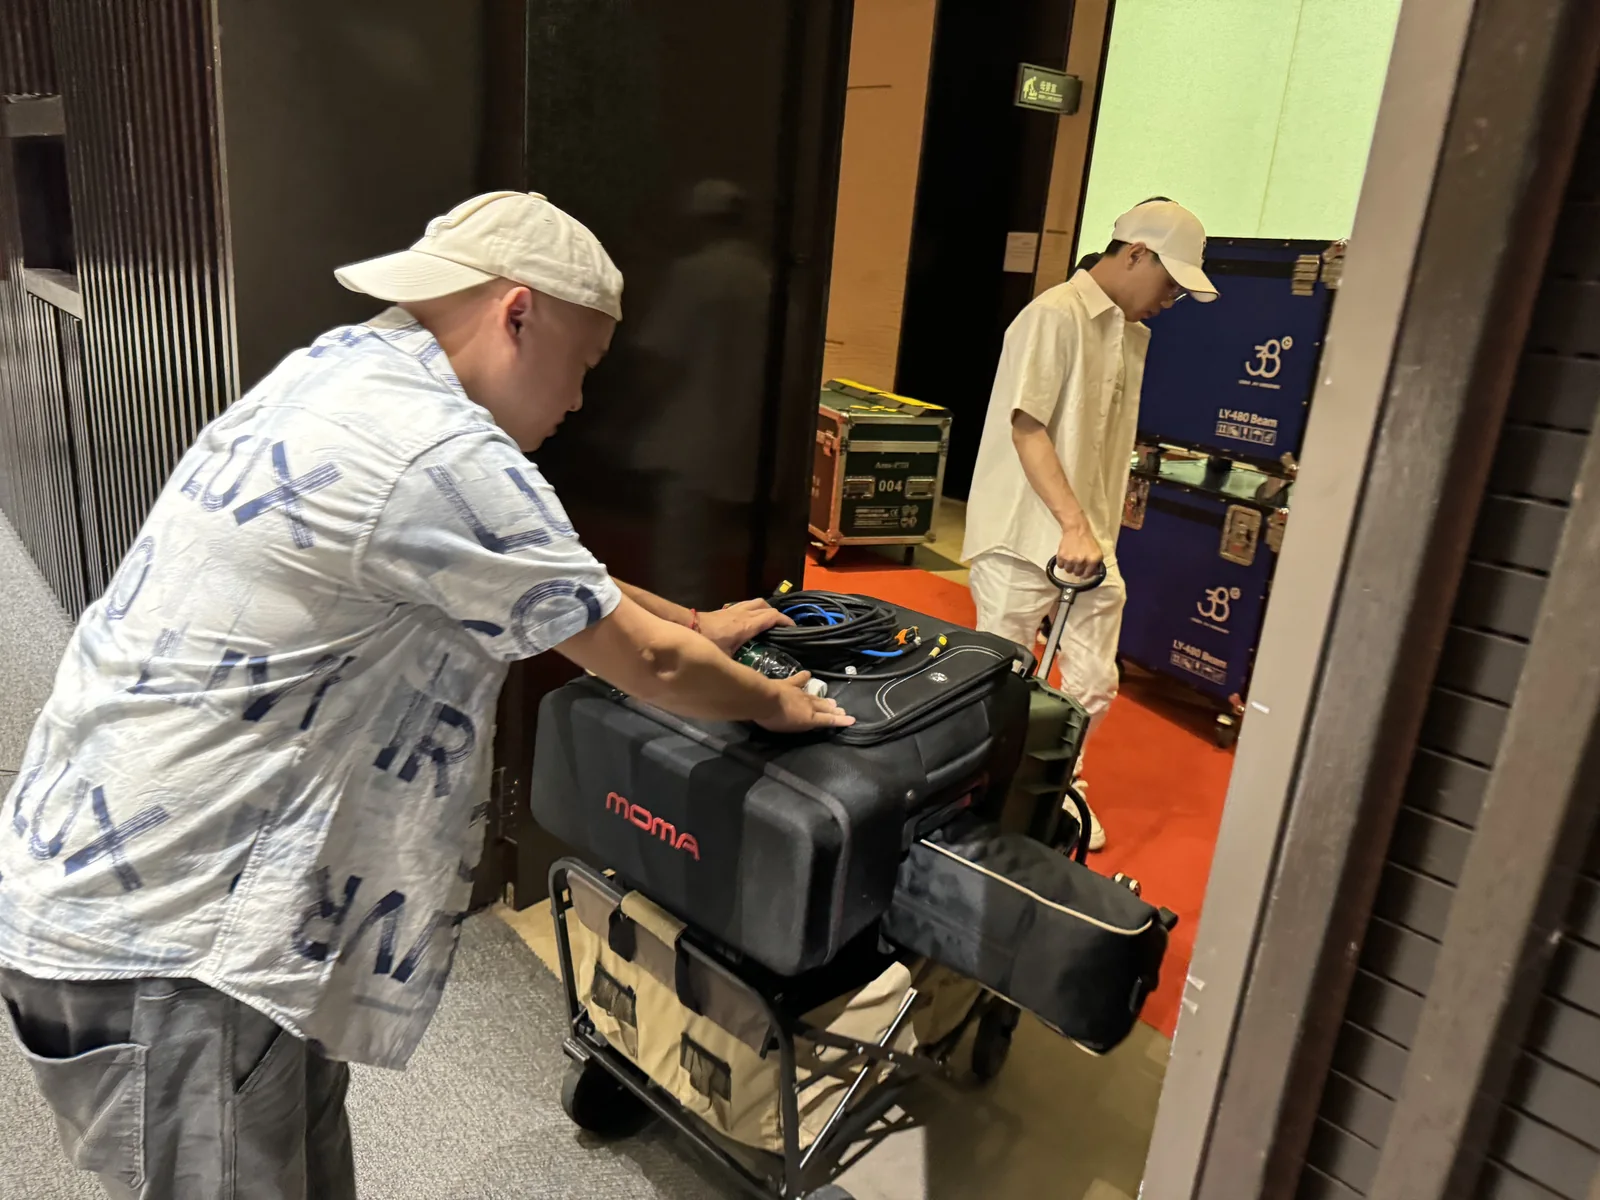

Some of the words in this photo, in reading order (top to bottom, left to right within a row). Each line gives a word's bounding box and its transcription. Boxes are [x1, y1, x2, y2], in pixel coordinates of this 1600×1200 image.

[1219, 408, 1249, 423] LY-480
[1250, 413, 1278, 428] Beam
[878, 480, 903, 492] 004
